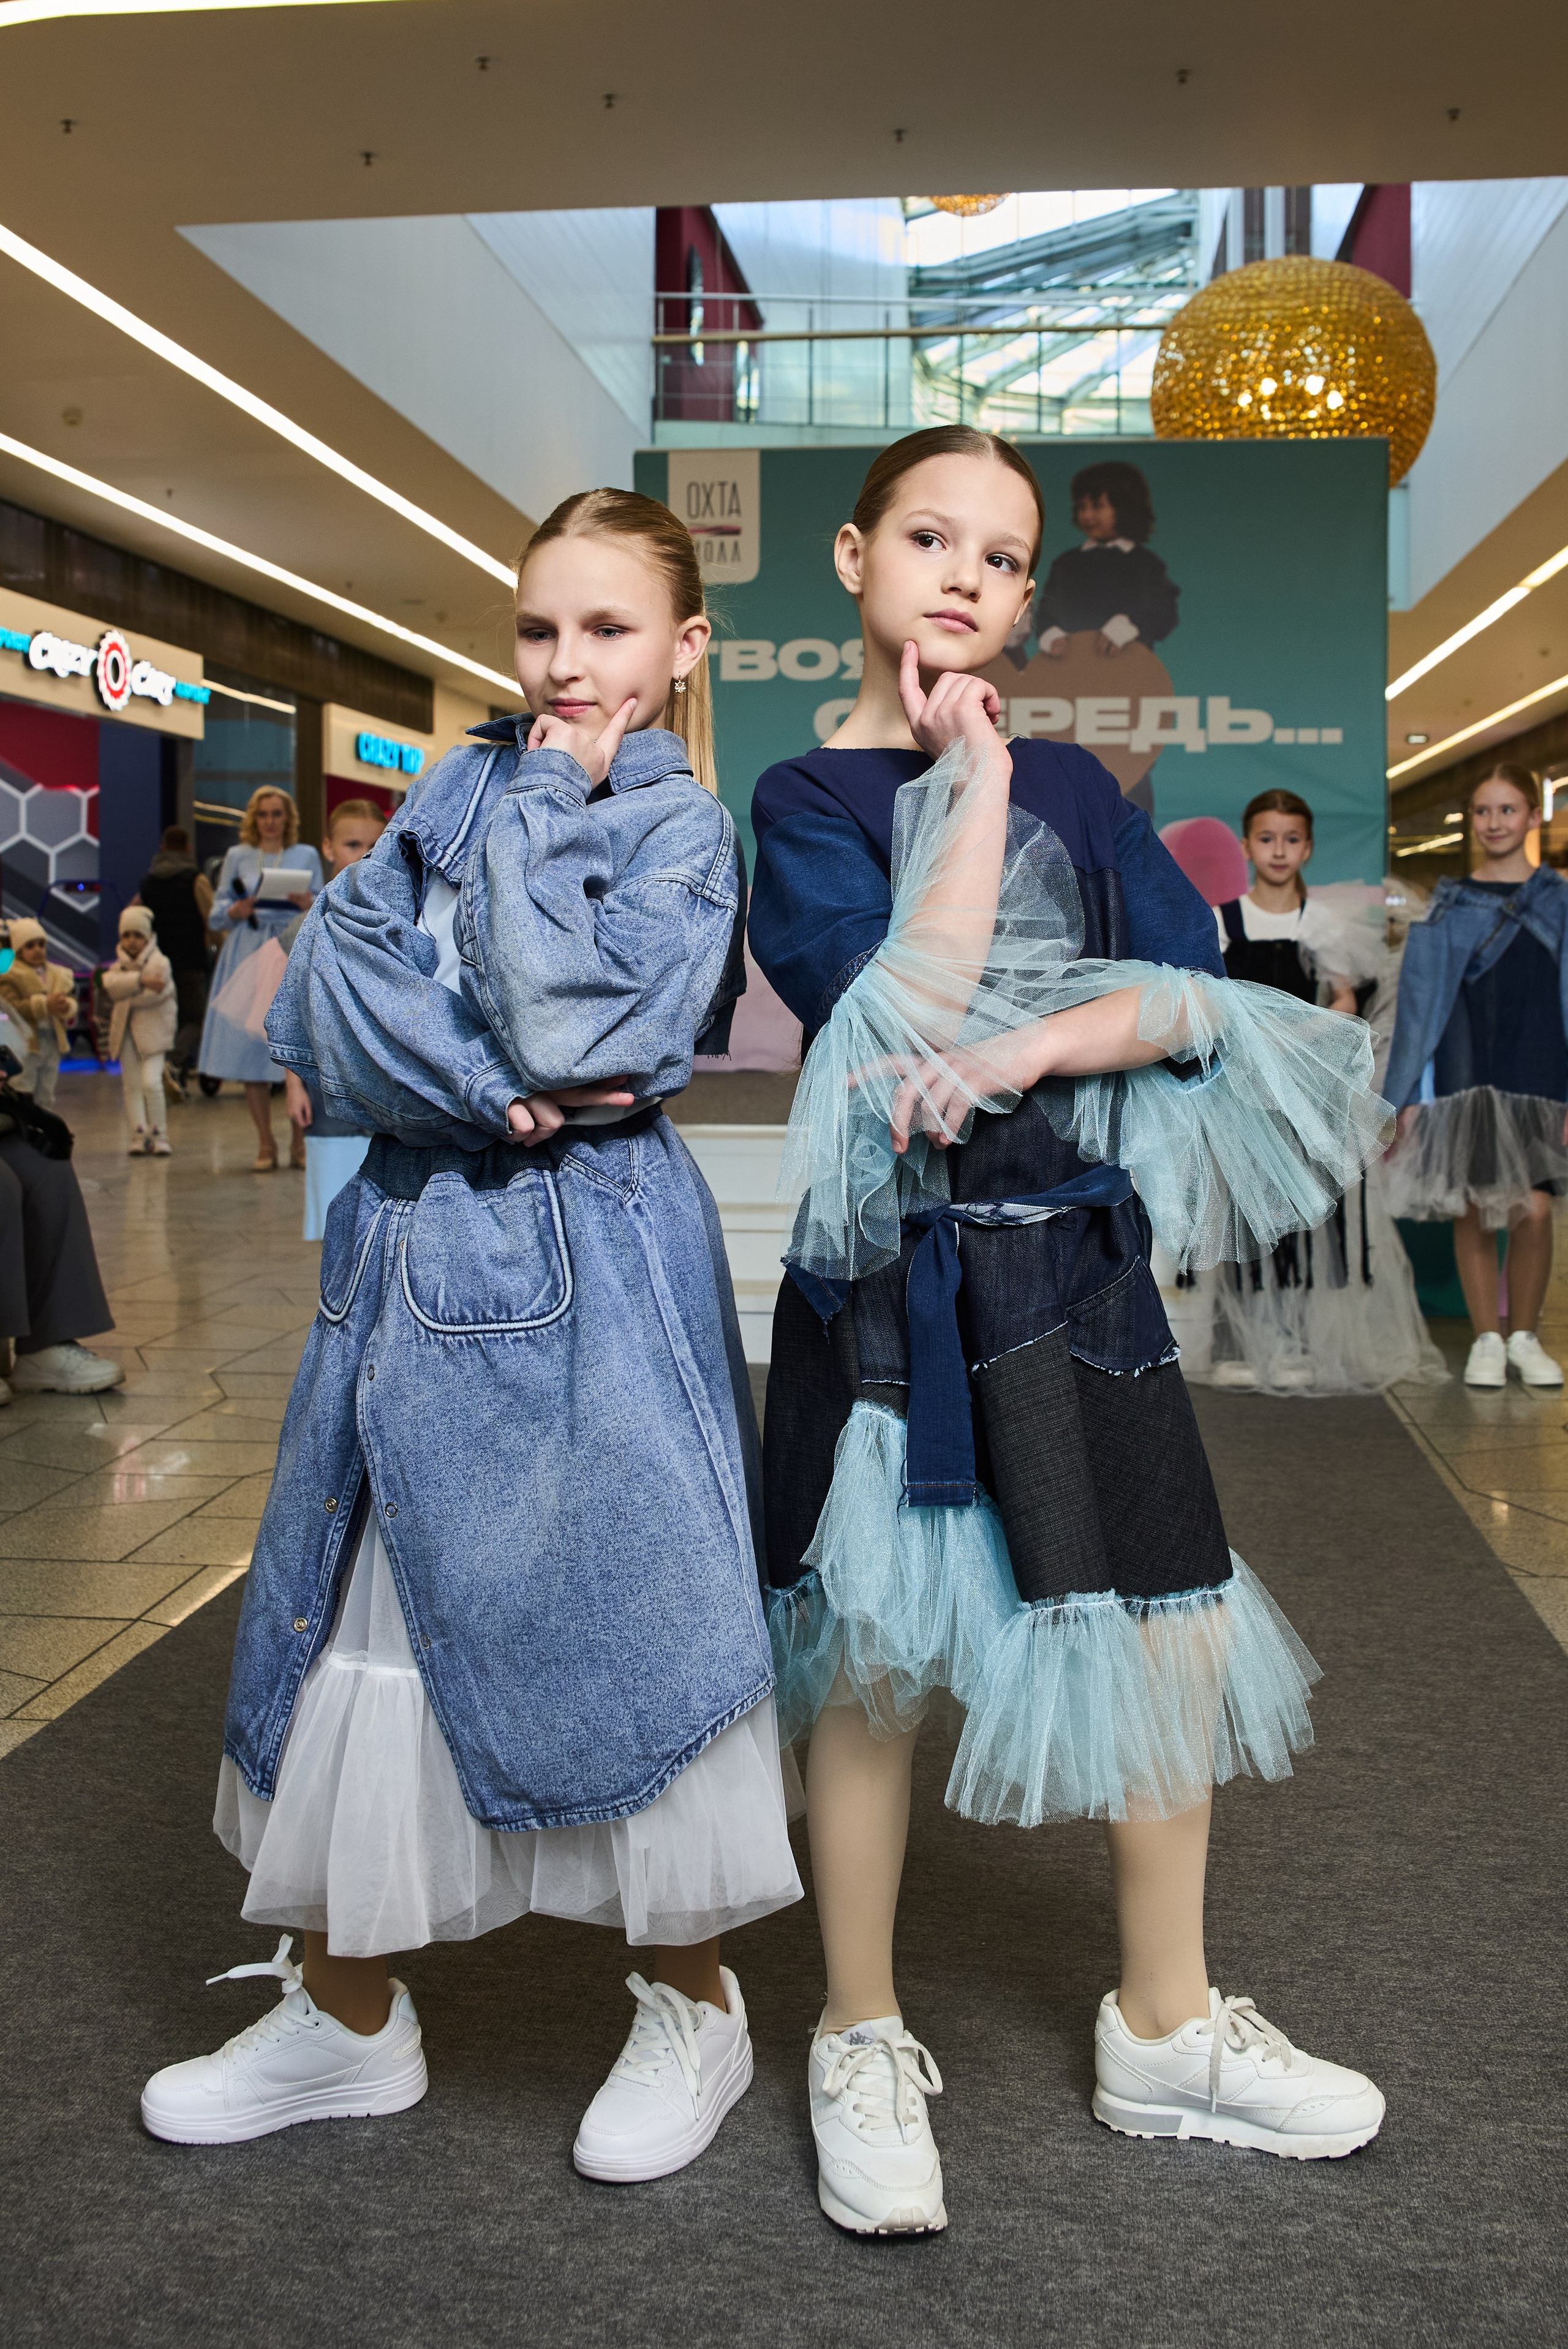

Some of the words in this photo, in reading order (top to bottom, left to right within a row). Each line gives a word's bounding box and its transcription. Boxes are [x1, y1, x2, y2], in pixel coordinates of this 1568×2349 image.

[687, 480, 742, 519] ОХТА
[708, 638, 864, 681] ВО
[813, 695, 1343, 753] РЕДЬ...
